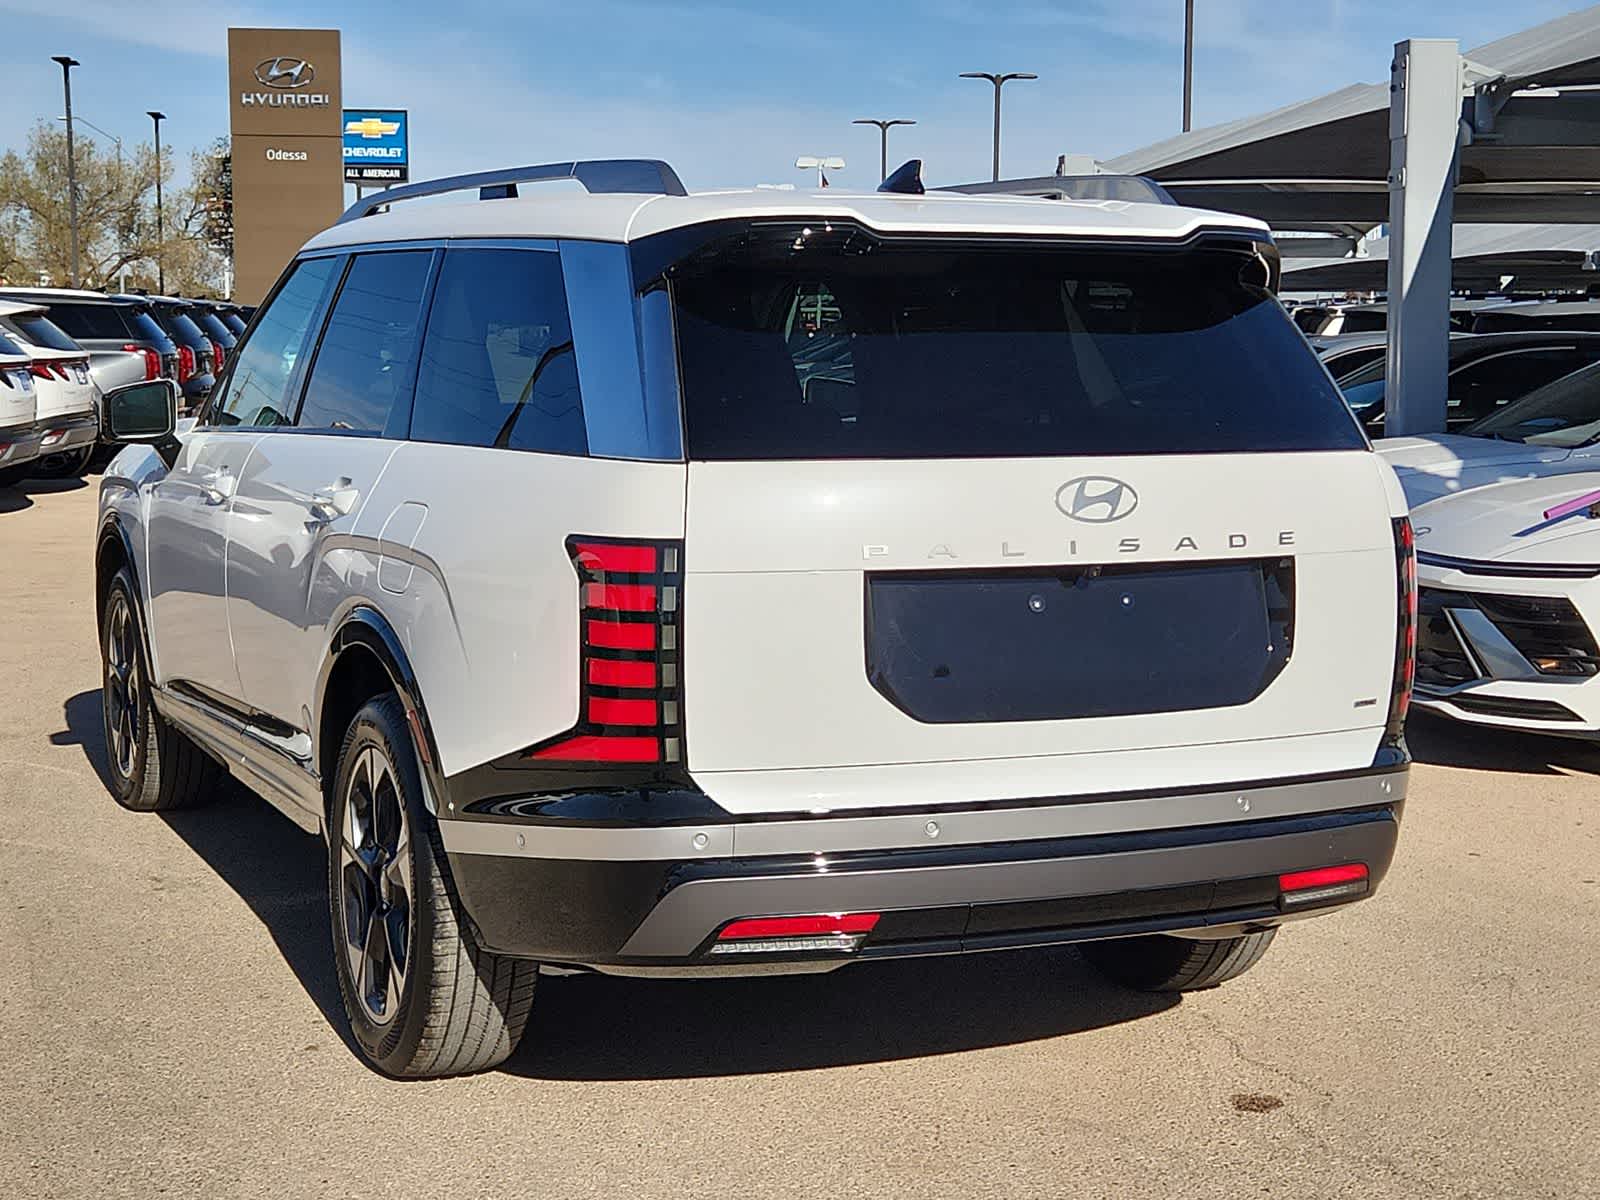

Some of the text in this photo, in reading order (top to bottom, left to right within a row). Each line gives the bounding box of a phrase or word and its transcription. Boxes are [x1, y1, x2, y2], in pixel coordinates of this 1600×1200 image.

[242, 93, 329, 106] HYUNDAI
[266, 149, 307, 161] Odessa
[343, 147, 403, 157] CHEVROLET
[346, 168, 400, 178] ALL AMERICAN
[863, 530, 1296, 560] PALISADE
